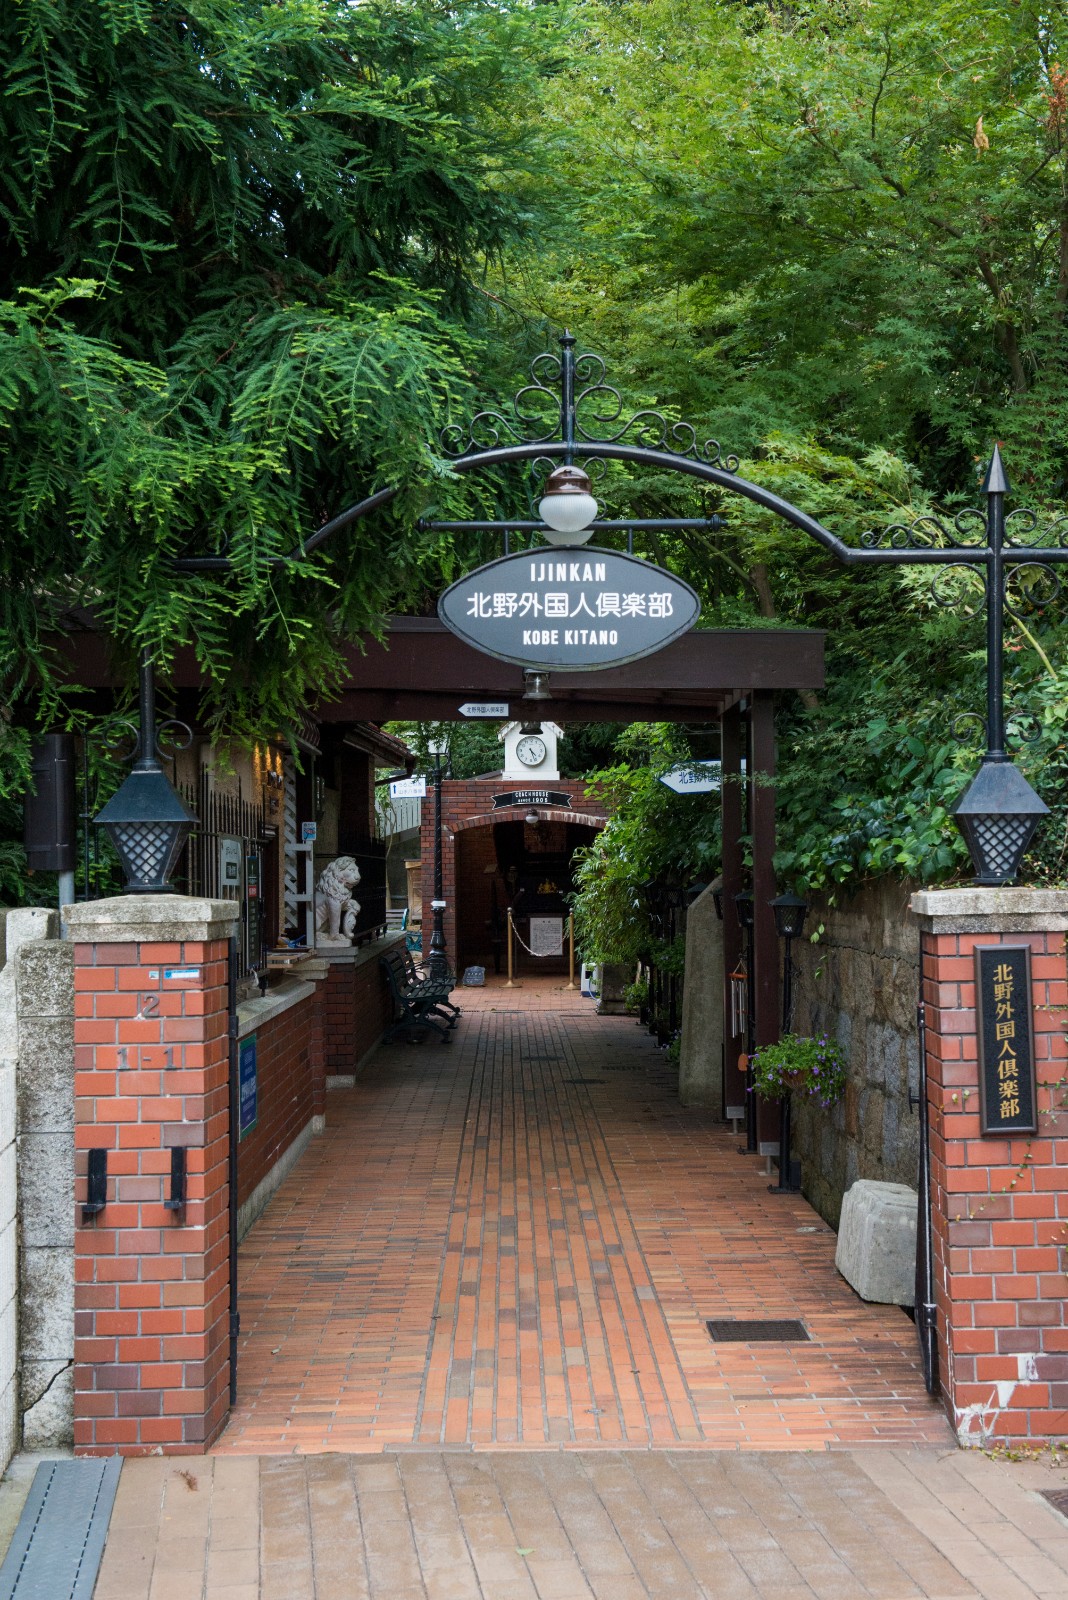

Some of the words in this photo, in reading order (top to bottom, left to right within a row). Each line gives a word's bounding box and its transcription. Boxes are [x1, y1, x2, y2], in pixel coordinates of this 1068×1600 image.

[530, 563, 606, 582] IJINKAN
[466, 592, 674, 619] 北野外国人倶楽部
[523, 630, 559, 645] KOBE
[564, 630, 618, 645] KITANO
[142, 992, 160, 1017] 2
[993, 964, 1020, 1119] 北野外国人倶楽部
